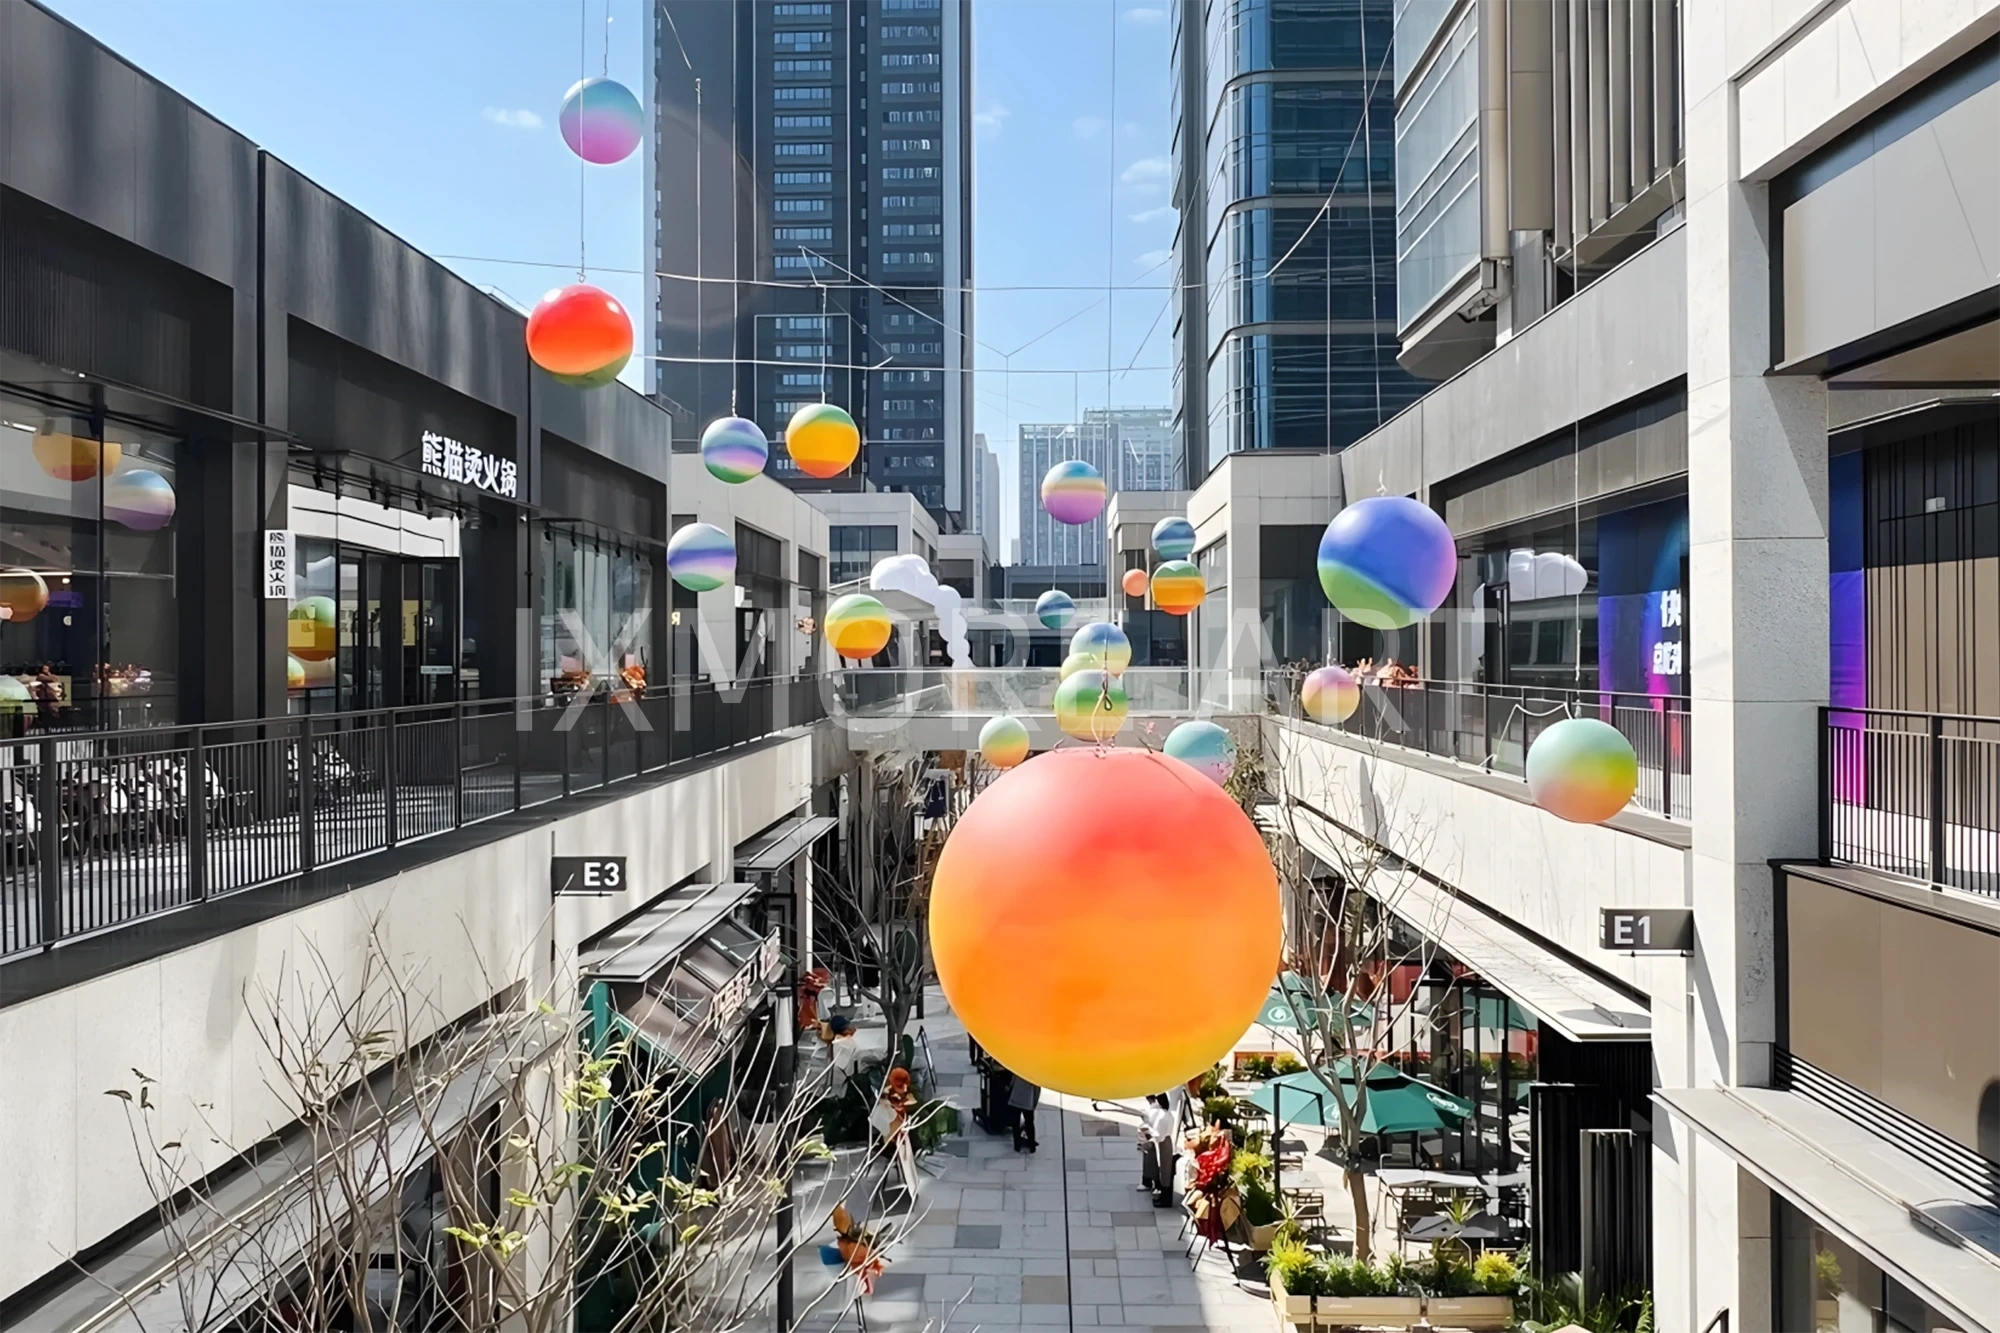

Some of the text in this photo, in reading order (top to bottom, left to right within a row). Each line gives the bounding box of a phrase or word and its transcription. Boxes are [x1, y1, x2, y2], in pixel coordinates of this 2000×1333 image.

[421, 430, 517, 498] 熊猫烫火锅
[583, 861, 620, 887] E3
[1613, 915, 1651, 945] E1
